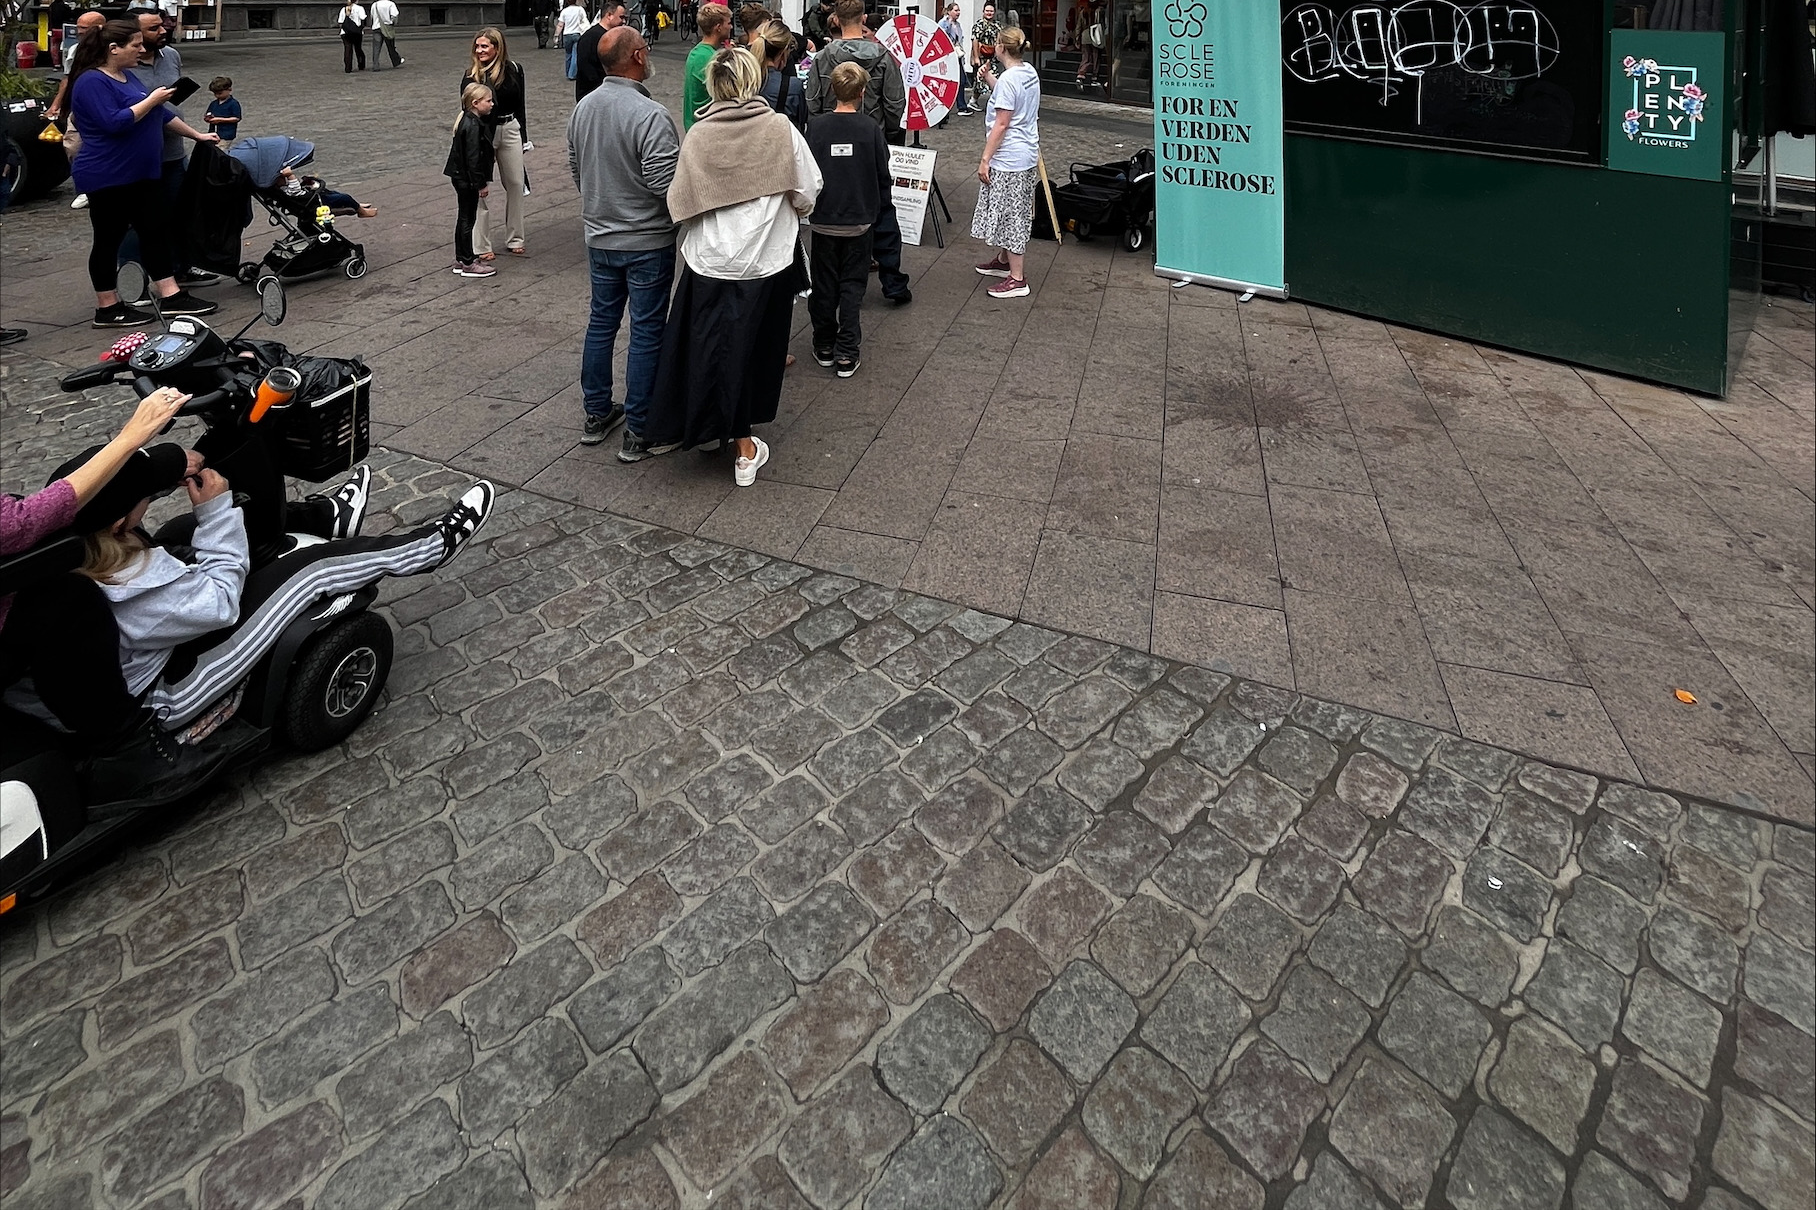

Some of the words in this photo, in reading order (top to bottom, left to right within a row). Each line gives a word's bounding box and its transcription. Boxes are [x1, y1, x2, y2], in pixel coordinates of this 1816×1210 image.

[1159, 44, 1214, 61] SCLE
[1160, 62, 1215, 79] ROSE
[1645, 74, 1684, 91] PL
[1161, 96, 1204, 116] FOR
[1210, 98, 1238, 118] EN
[1645, 93, 1684, 111] EN
[1161, 119, 1251, 143] VERDEN
[1645, 113, 1684, 131] TY
[1638, 137, 1689, 149] FLOWERS
[1162, 142, 1221, 164] UDEN
[1162, 165, 1275, 195] SCLEROSE
